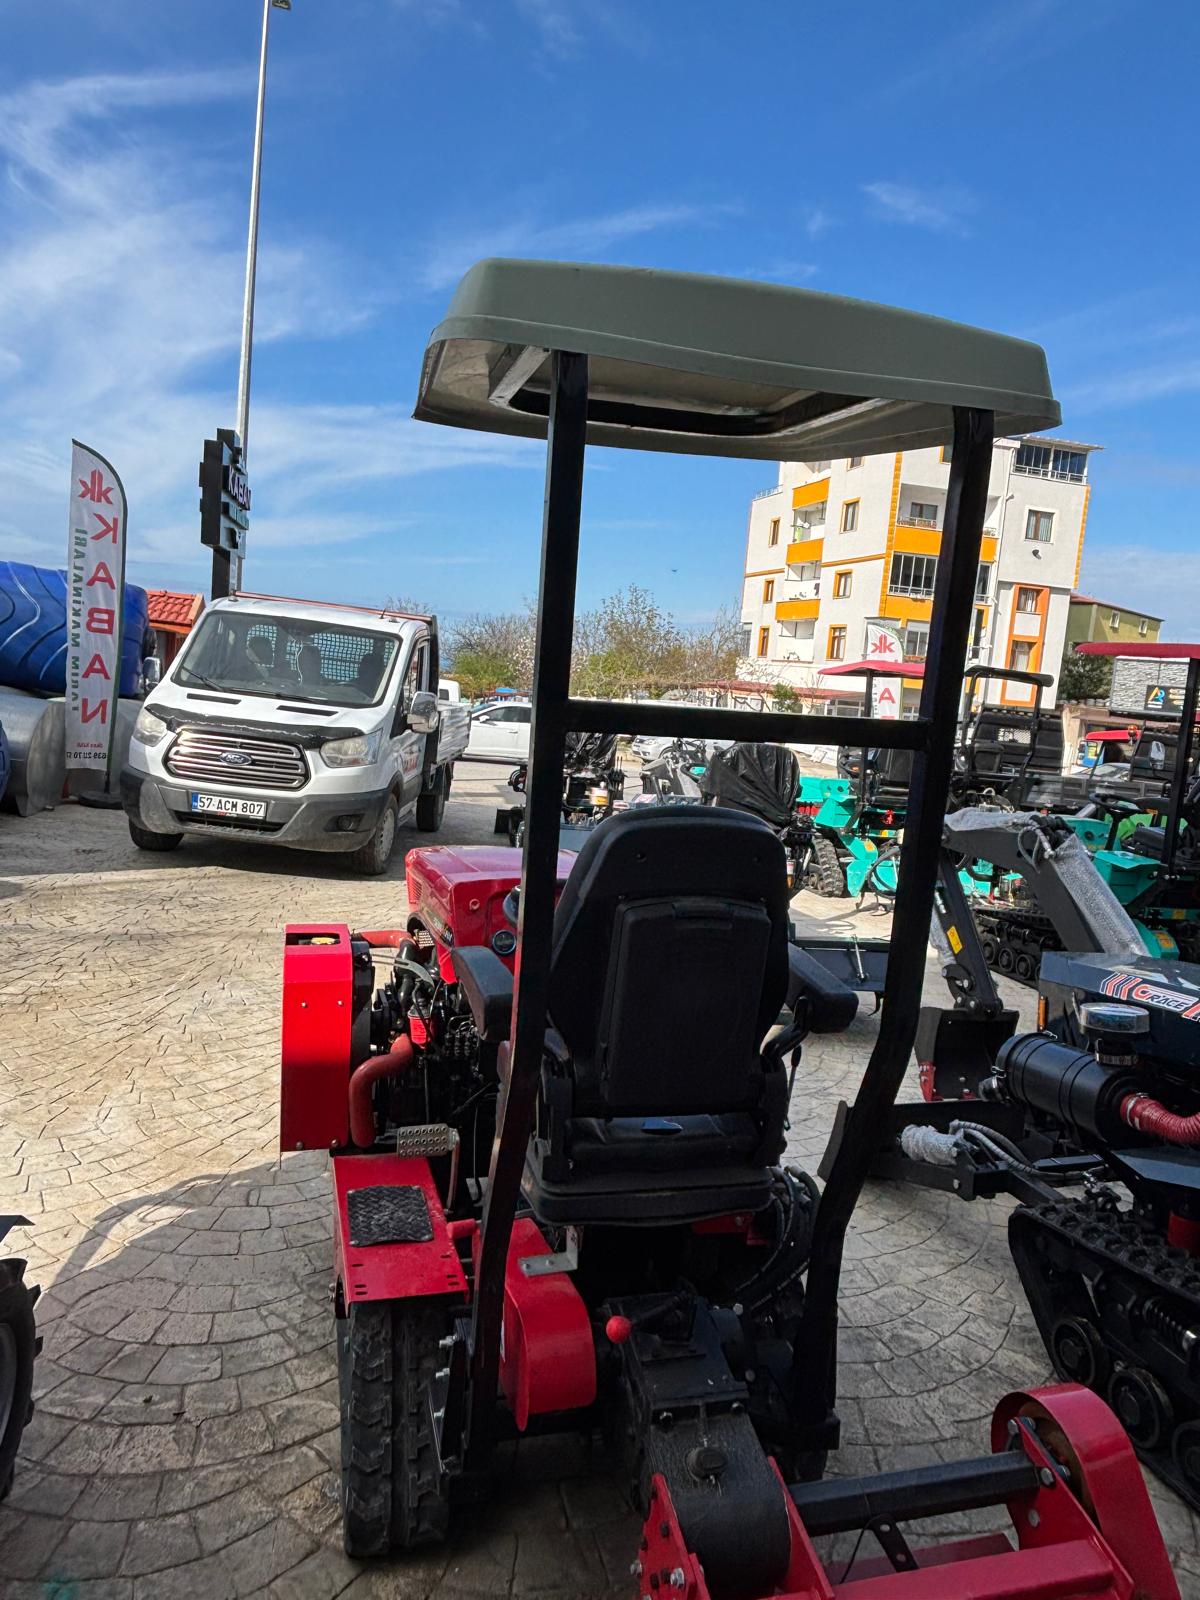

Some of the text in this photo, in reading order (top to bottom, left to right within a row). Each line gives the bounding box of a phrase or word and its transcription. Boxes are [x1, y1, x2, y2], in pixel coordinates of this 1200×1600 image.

[199, 796, 213, 809] 57
[216, 799, 238, 813] ACM
[241, 802, 263, 815] 807
